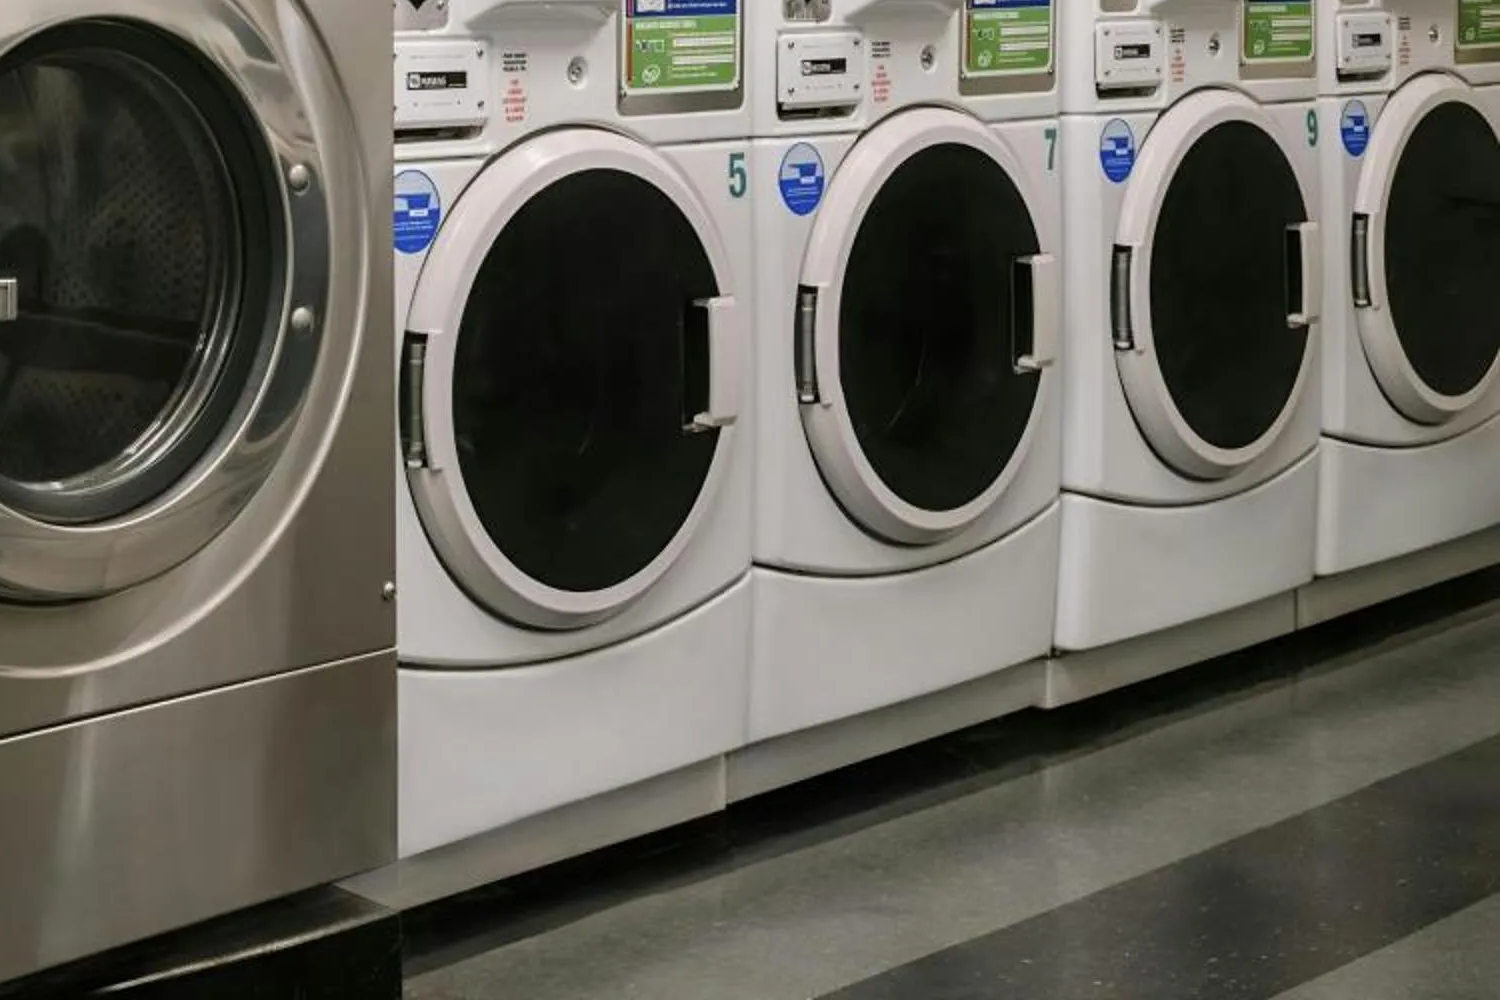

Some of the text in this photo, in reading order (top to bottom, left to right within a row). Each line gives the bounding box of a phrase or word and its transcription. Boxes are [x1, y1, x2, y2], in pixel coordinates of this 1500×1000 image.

[1044, 128, 1057, 170] 7
[1307, 108, 1318, 148] 9
[729, 152, 746, 198] 5
